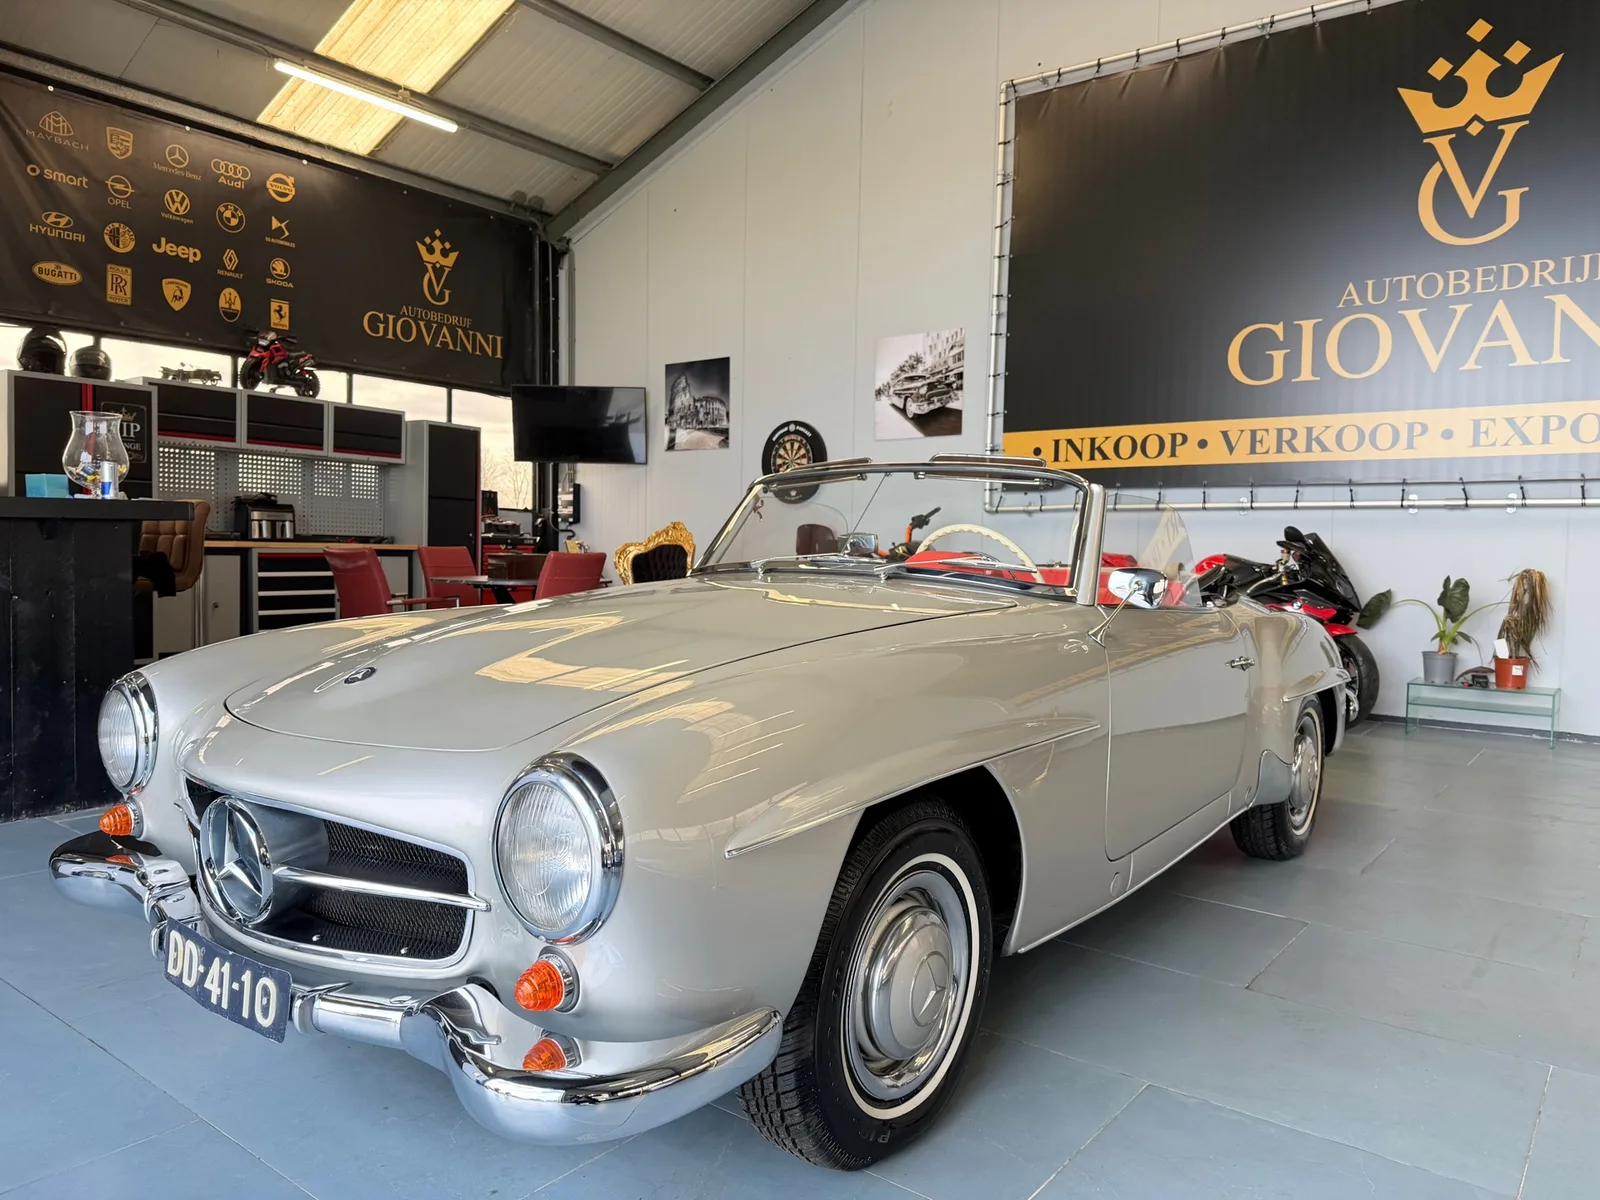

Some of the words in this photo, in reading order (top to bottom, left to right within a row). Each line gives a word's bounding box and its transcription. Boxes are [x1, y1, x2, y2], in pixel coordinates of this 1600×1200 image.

[25, 128, 89, 151] MAYBACH
[43, 168, 88, 189] smart
[218, 175, 245, 190] Audi
[269, 182, 293, 194] VOLVO
[107, 196, 132, 209] OPEL
[160, 211, 194, 225] Volkswagen
[29, 223, 85, 243] HYUNDAI
[152, 237, 202, 263] Jeep
[37, 266, 77, 281] BUGATTI
[216, 269, 244, 280] RENAULT
[400, 305, 473, 329] AUTOBEDRIJF
[362, 310, 504, 359] GIOVANNI
[1051, 432, 1189, 463] INKOOP
[1219, 421, 1430, 457] VERKOOP
[167, 930, 277, 1028] DD-41-10
